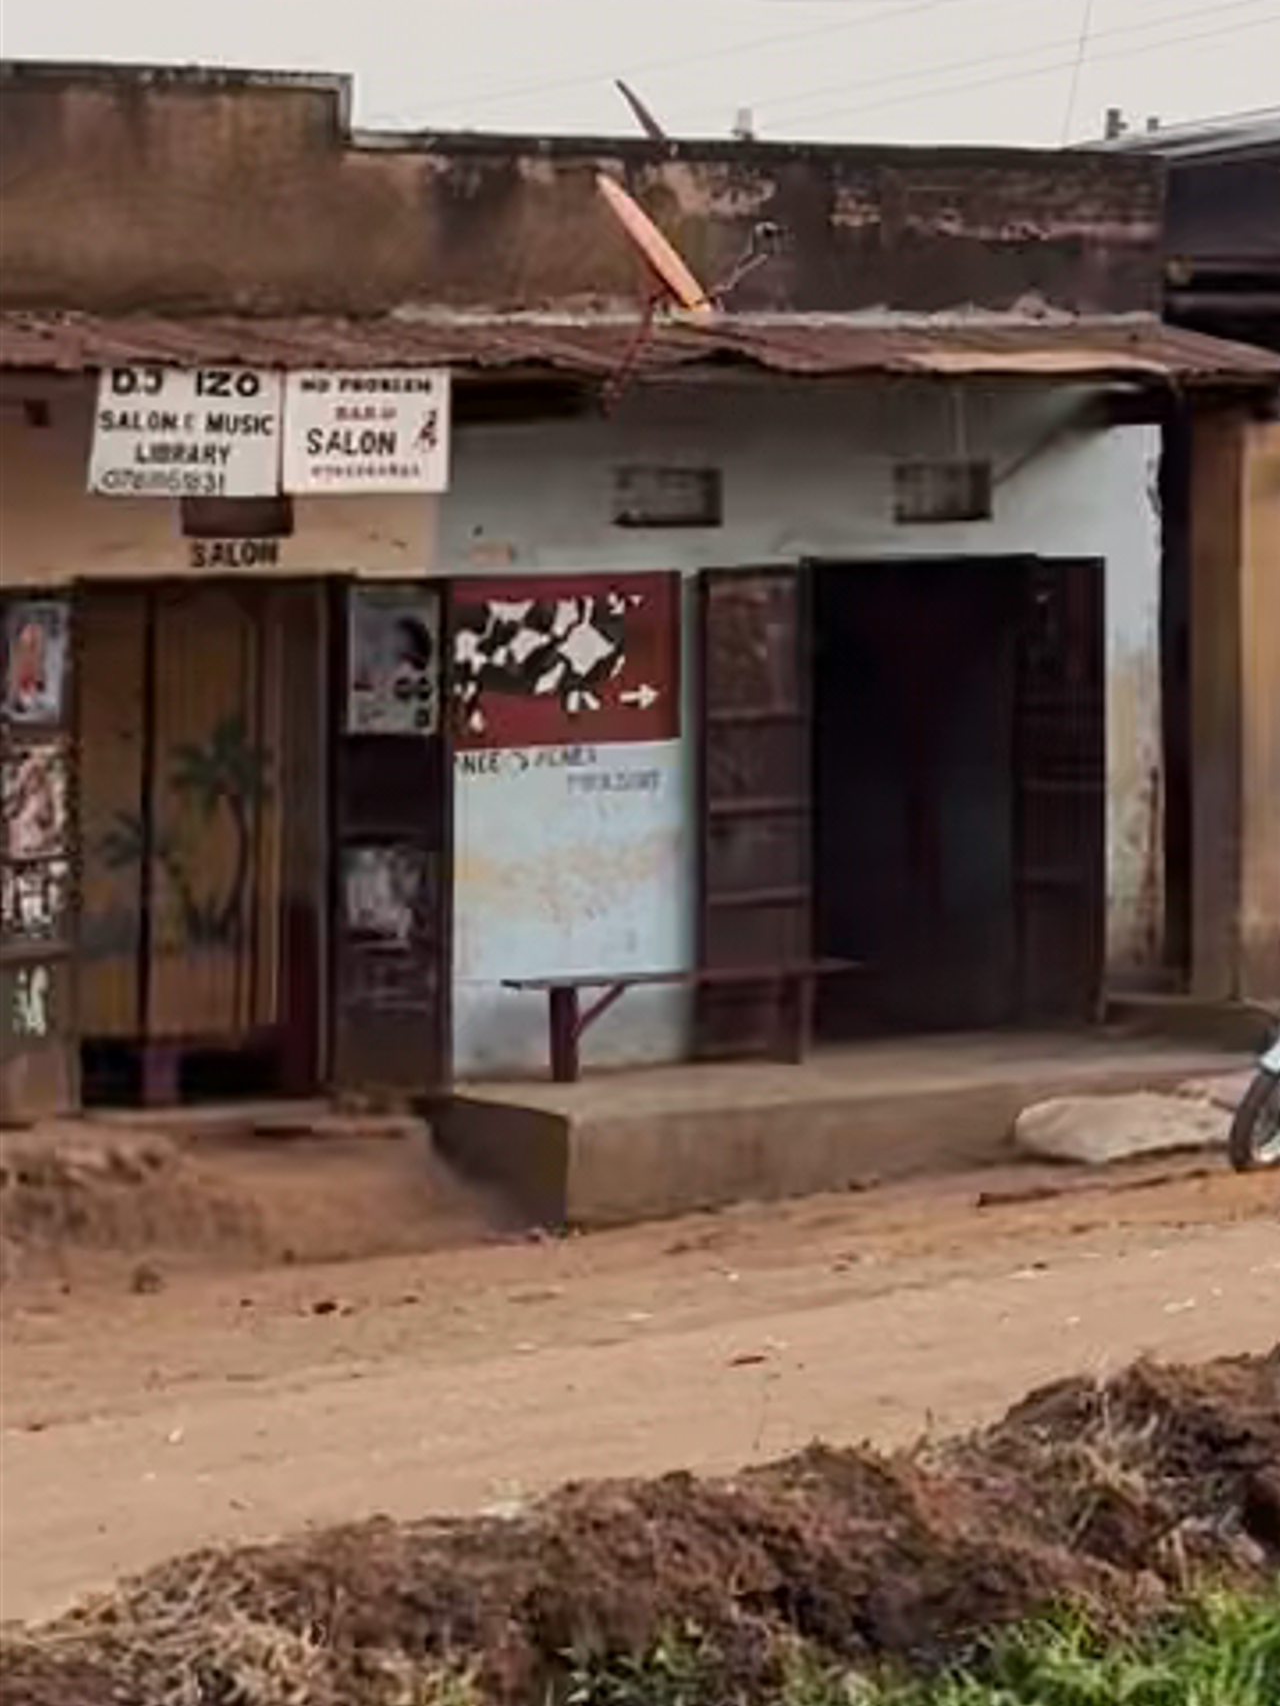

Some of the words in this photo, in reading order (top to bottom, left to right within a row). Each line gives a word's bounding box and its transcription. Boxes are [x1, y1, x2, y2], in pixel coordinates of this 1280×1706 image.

[196, 369, 260, 397] IZO
[100, 411, 178, 432] SALON
[205, 411, 273, 436] MUSIC
[135, 442, 231, 466] LIBRARY
[306, 427, 398, 456] SALON
[189, 541, 279, 568] SALON
